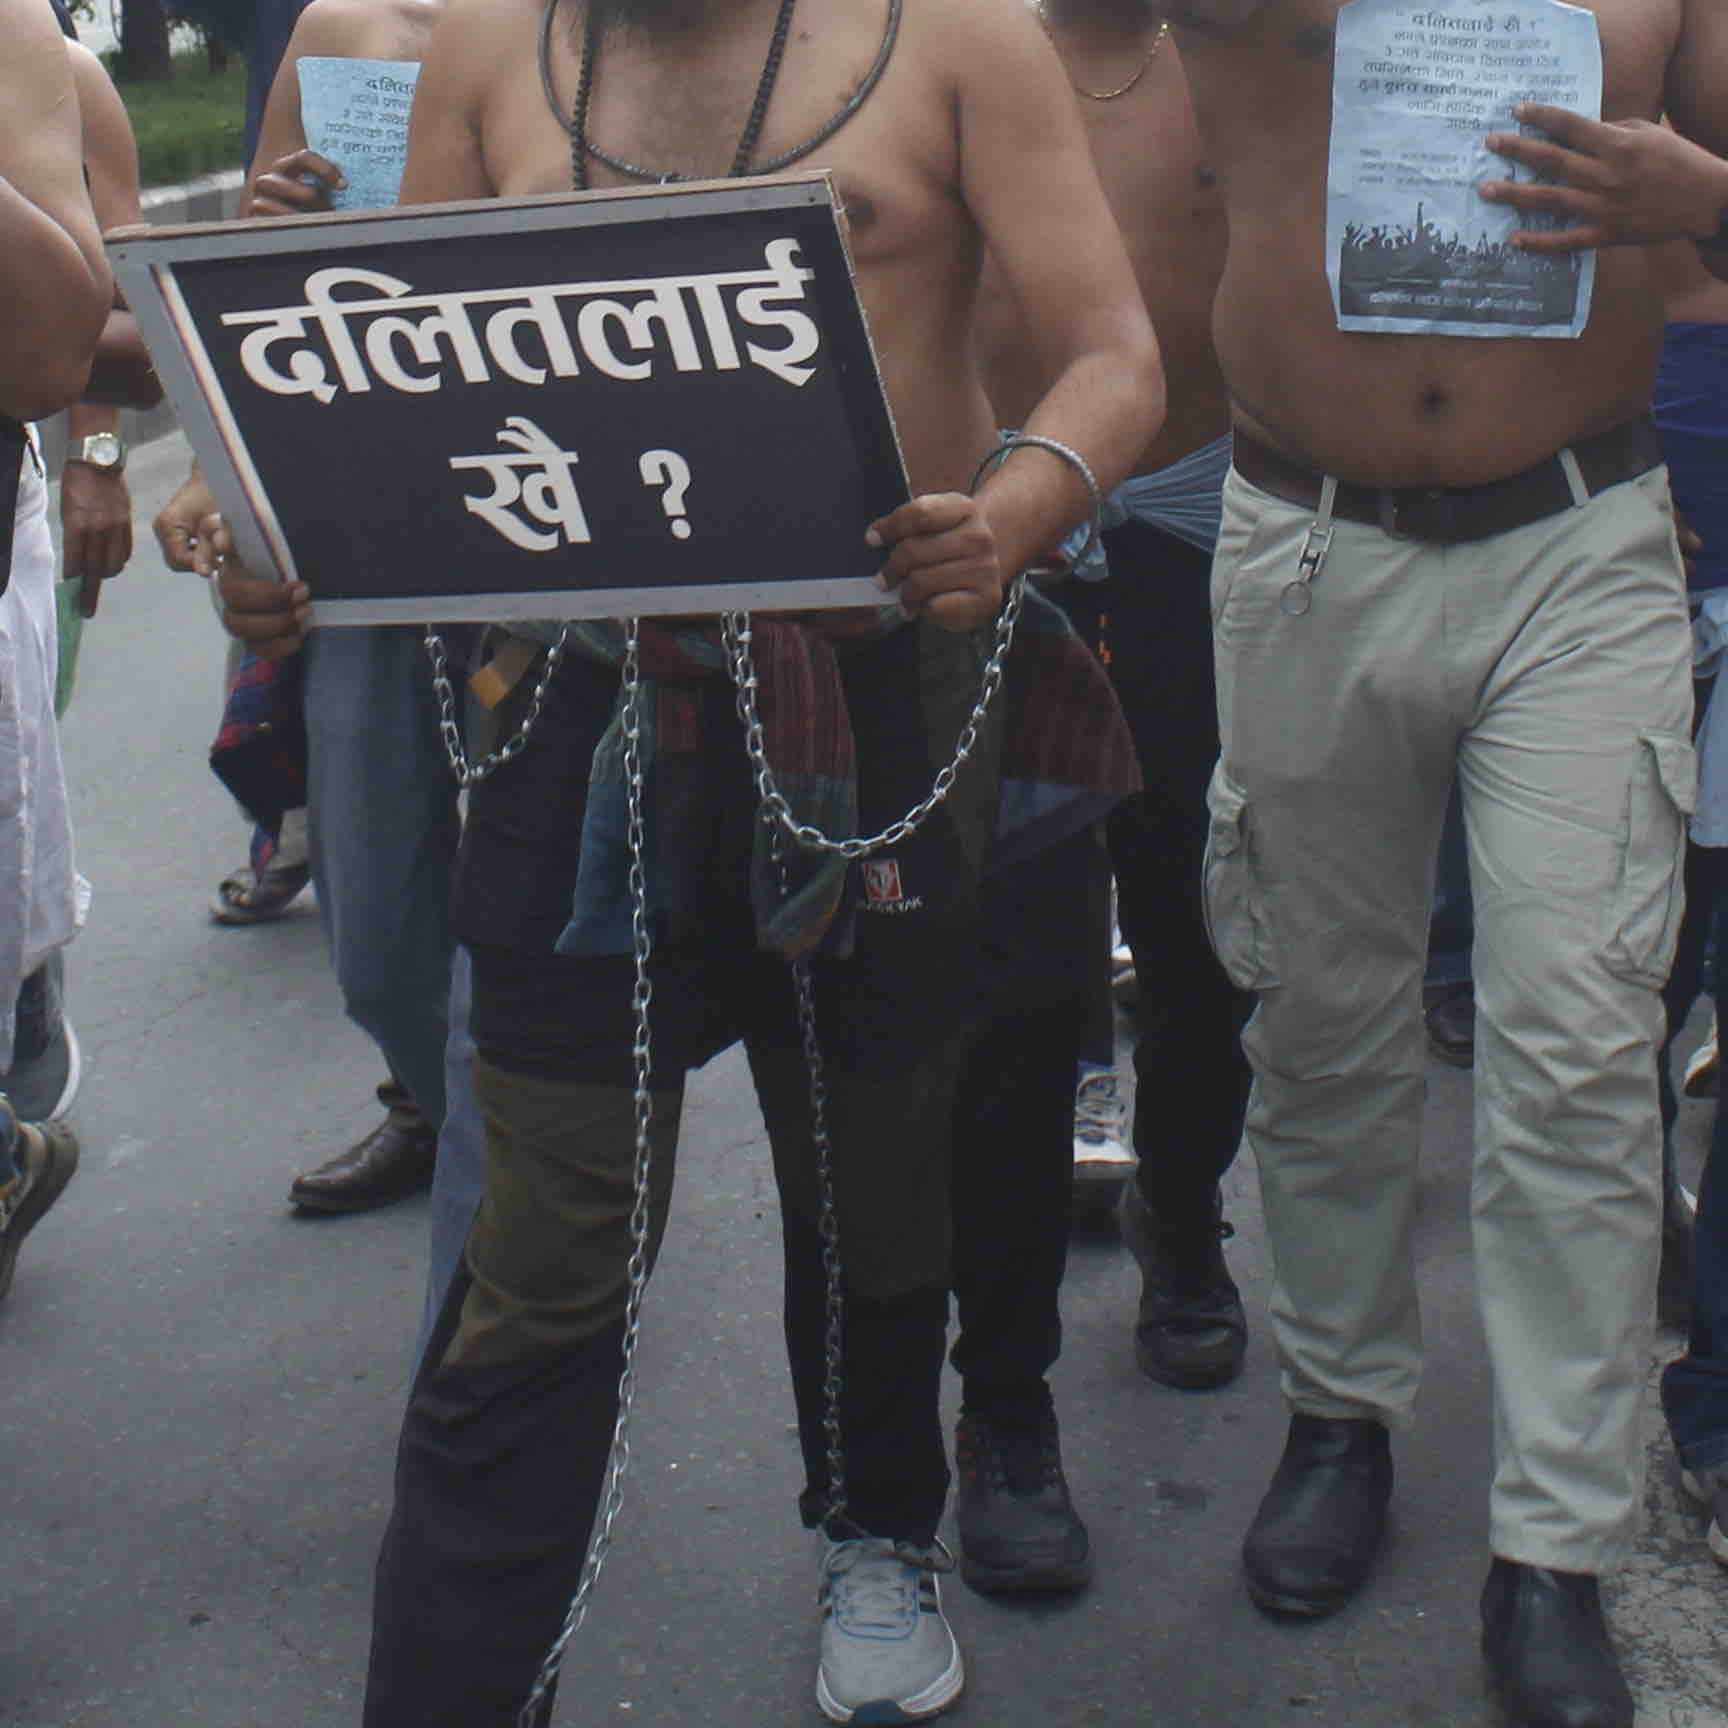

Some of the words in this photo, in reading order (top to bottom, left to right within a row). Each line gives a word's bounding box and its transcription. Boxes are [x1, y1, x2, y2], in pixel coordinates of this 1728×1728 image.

[221, 237, 820, 404] दलितलाई
[450, 416, 591, 551] खै
[639, 449, 691, 539] ?
